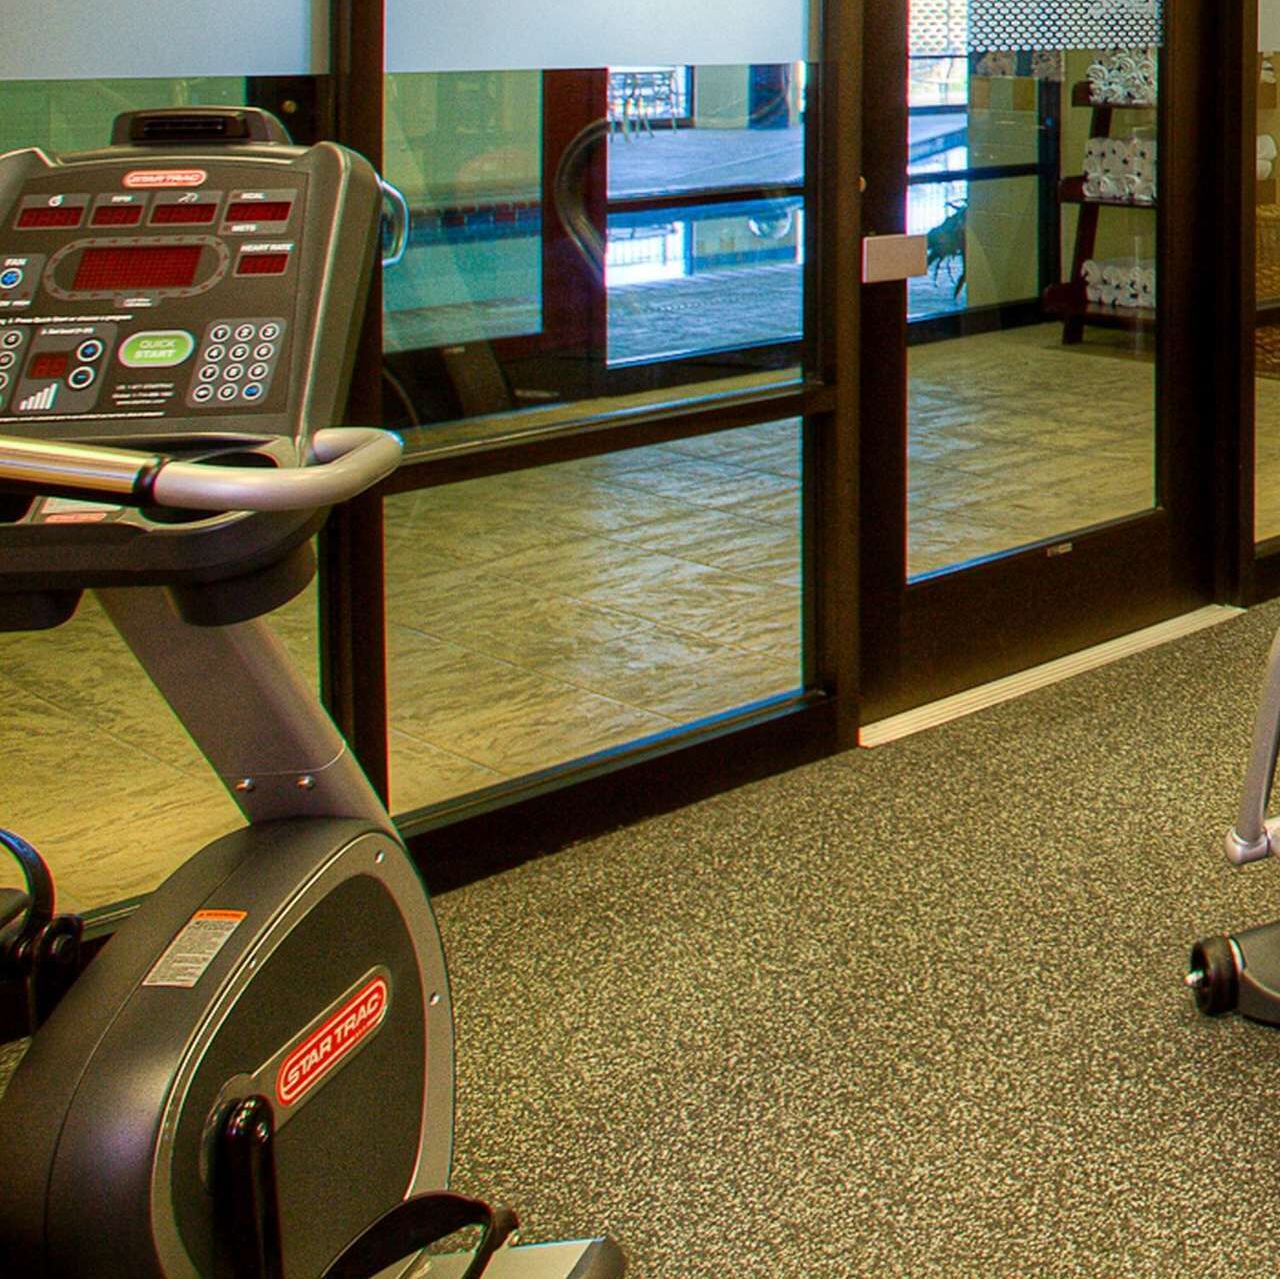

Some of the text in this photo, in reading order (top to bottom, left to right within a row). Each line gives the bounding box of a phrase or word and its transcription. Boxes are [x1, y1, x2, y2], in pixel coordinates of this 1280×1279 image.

[139, 340, 177, 349] QUICK
[134, 349, 177, 359] START
[287, 991, 381, 1085] STAR TRAC
